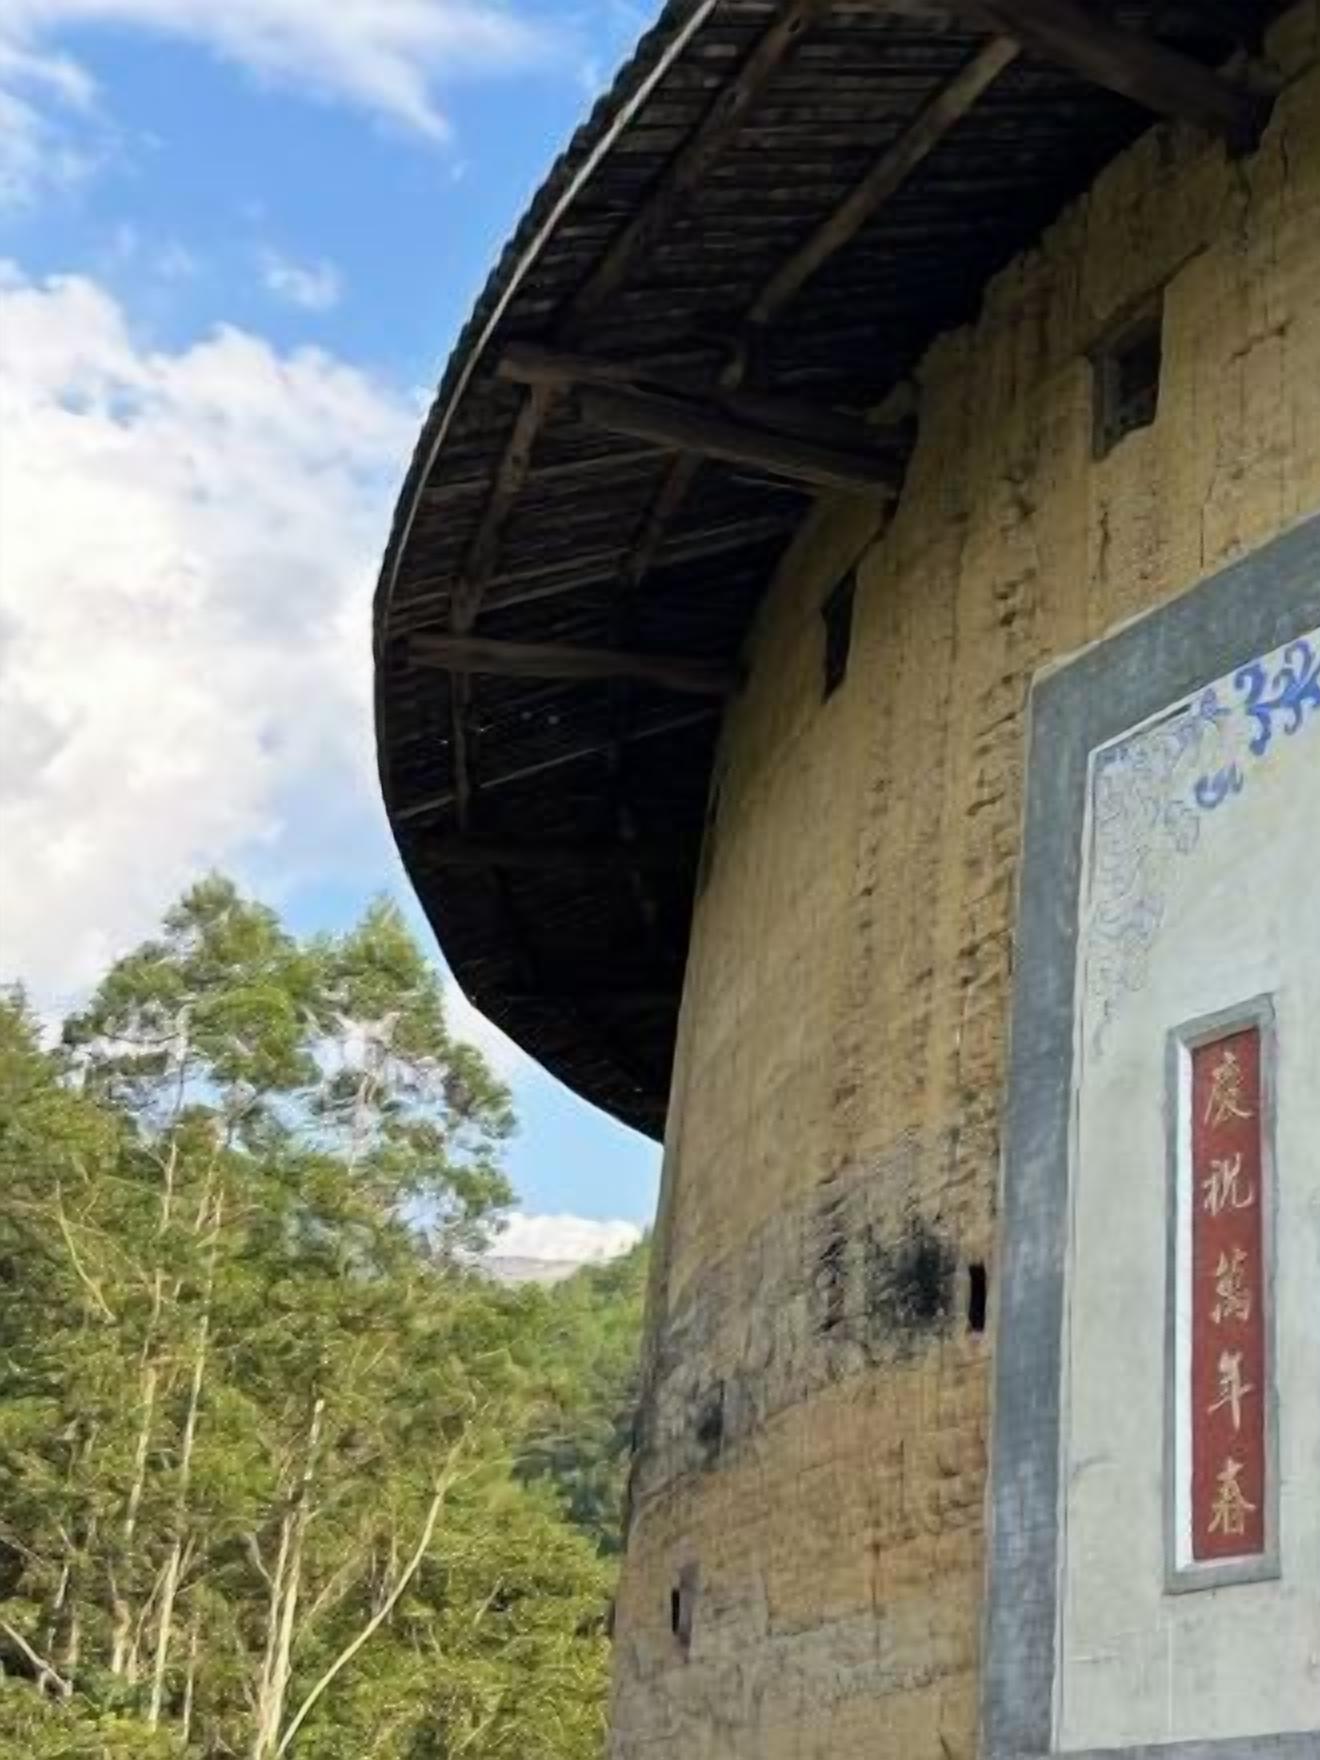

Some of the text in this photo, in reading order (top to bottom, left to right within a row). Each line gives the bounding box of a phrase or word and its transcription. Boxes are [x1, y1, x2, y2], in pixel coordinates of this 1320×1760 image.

[1203, 1052, 1256, 1536] 慶祝萬年春
